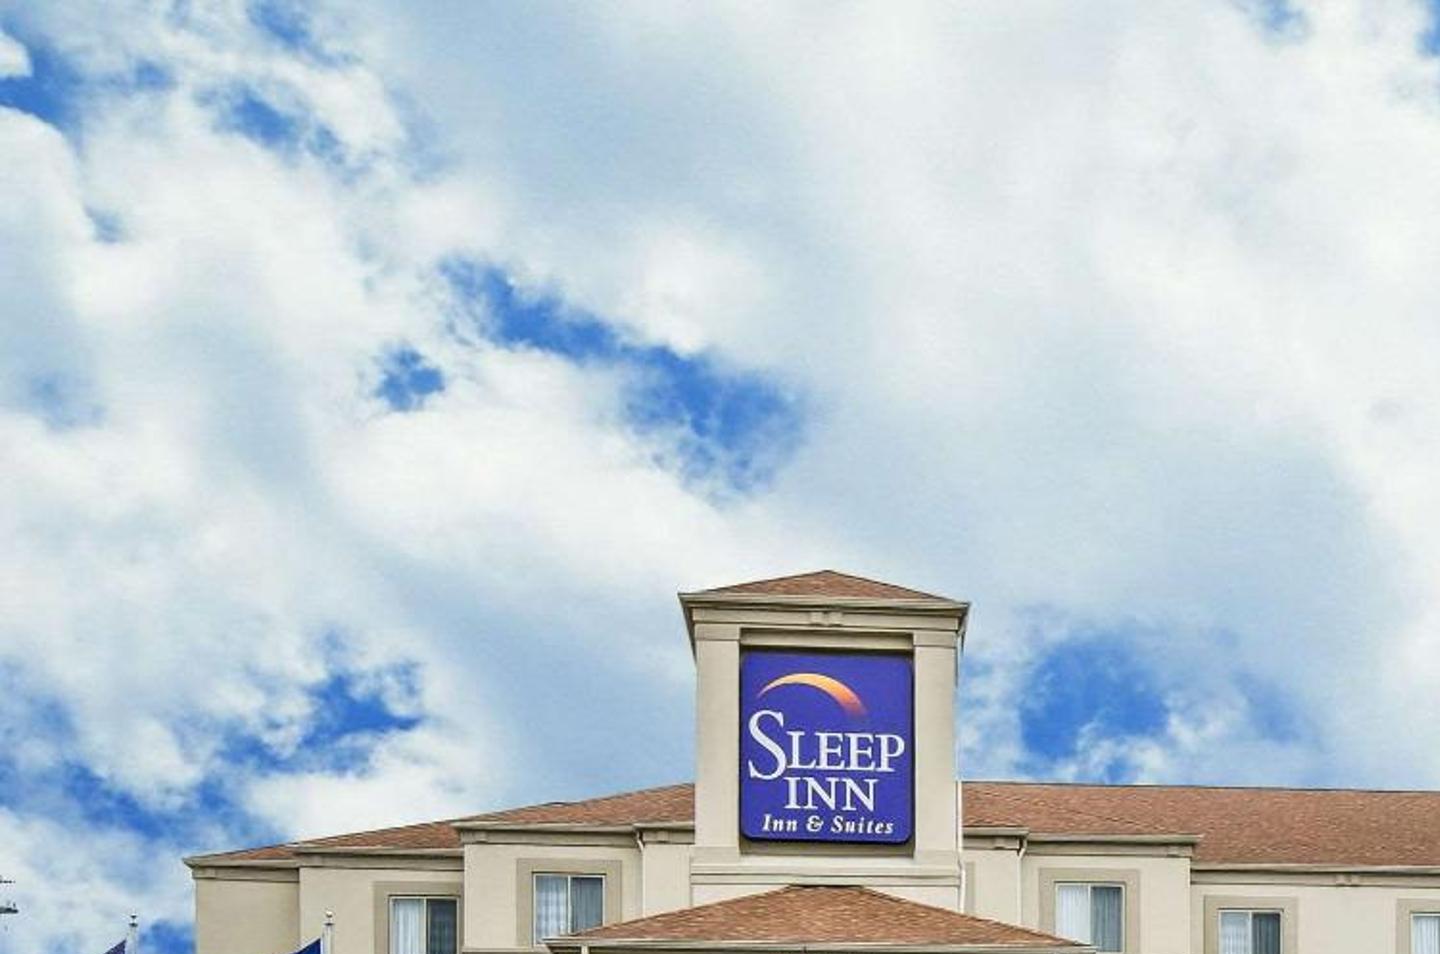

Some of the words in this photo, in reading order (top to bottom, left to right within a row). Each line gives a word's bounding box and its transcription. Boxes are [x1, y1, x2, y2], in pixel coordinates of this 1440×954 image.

[748, 709, 905, 780] SLEEP
[783, 776, 879, 812] INN
[762, 813, 798, 832] Inn
[806, 815, 824, 833] &
[830, 815, 894, 834] Suites
